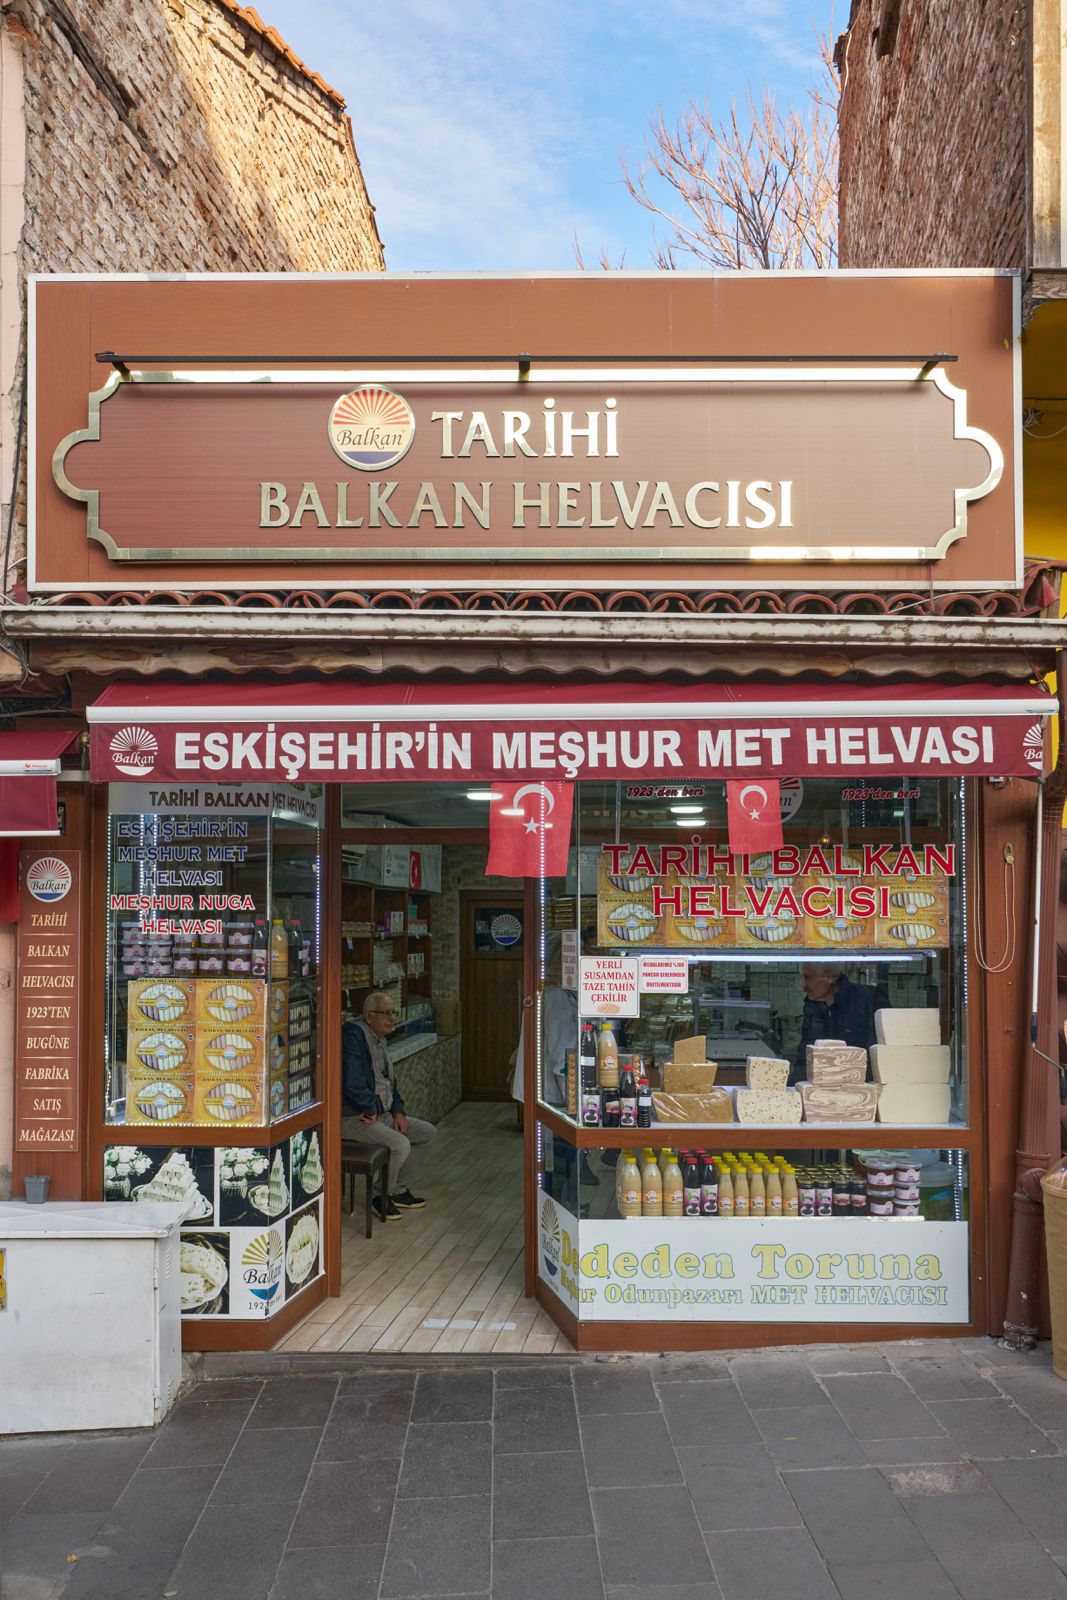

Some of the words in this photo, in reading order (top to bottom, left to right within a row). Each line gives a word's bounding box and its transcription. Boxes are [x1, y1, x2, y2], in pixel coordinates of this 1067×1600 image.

[431, 397, 619, 457] TARİHİ
[337, 427, 402, 450] Balkan
[259, 481, 492, 529] BALKAN
[513, 480, 794, 529] HELVACISI
[175, 723, 472, 779] ESKİŞEHİR'İN
[493, 729, 684, 778] MEŞHUR
[699, 728, 790, 768] MET
[806, 726, 994, 764] HELVASI
[112, 752, 154, 767] Balkan
[681, 784, 705, 797] beri
[842, 787, 895, 800] 1923'den
[897, 787, 921, 799] beri
[149, 788, 199, 807] TARİHİ
[204, 792, 269, 808] BALKAN
[272, 791, 286, 810] MET
[117, 817, 248, 841] ESKİŞEHİR'İN
[118, 847, 203, 866] MEŞHUR
[207, 846, 248, 863] MET
[772, 844, 956, 877] BALKAN
[142, 870, 223, 886] HELVASI
[30, 880, 67, 892] Balkan
[111, 895, 193, 916] MEŞHUR
[199, 895, 256, 910] NUGA
[652, 885, 891, 919] HELVACISI
[31, 911, 67, 926] TARİHİ
[141, 919, 223, 935] HELVASI
[27, 945, 70, 957] BALKAN
[596, 960, 622, 969] YERLİ
[22, 976, 75, 988] HELVACISI
[584, 971, 634, 980] SUSAMDAN
[583, 982, 605, 991] TAZE
[608, 981, 635, 992] TAHİN
[591, 993, 627, 1004] ÇEKİLİR
[26, 1006, 71, 1018] 1923'TEN
[26, 1034, 70, 1049] BUGÜNE
[25, 1066, 69, 1080] FABRİKA
[33, 1098, 61, 1114] SATIŞ
[20, 1127, 74, 1142] MAĞAZASI
[751, 1244, 942, 1280] Toruna
[604, 1283, 743, 1309] Odunpazarı
[751, 1285, 807, 1304] MET
[815, 1285, 948, 1306] HELVACISI
